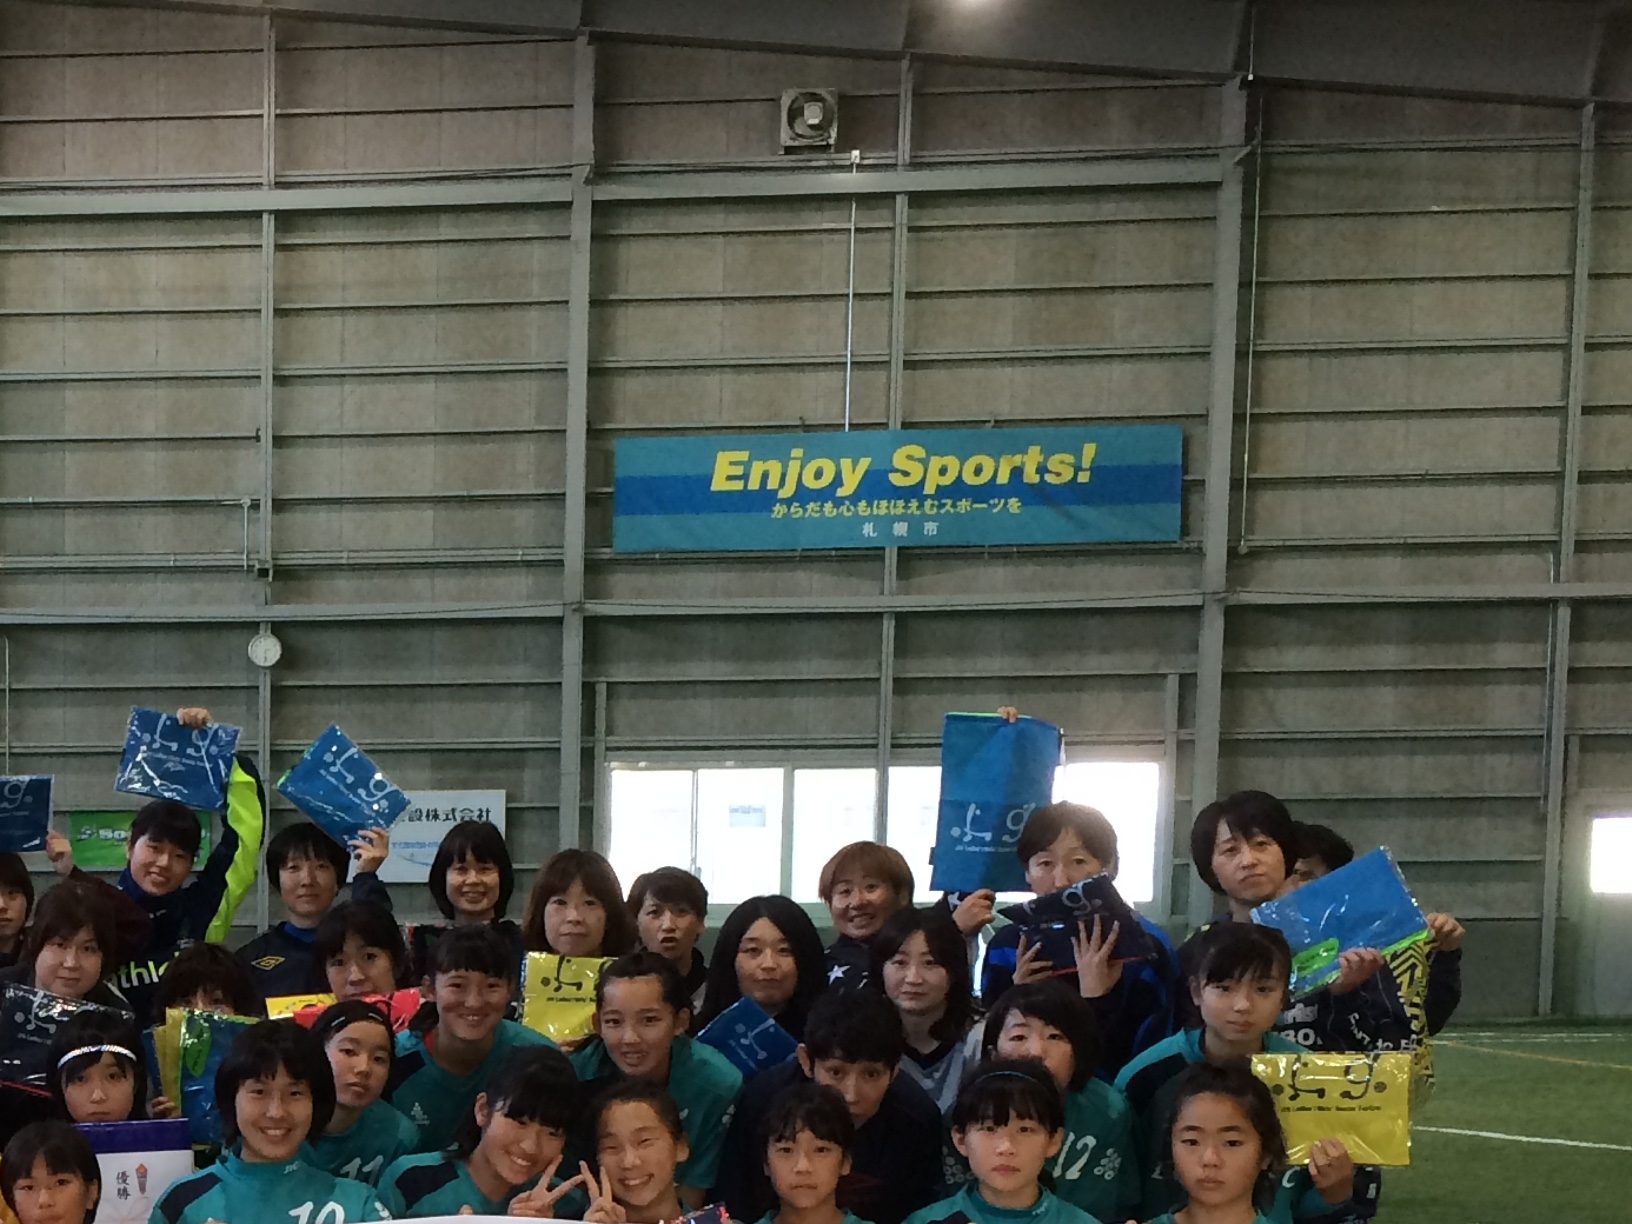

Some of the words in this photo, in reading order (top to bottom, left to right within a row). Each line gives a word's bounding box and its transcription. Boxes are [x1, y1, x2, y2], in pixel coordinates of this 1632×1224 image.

[710, 448, 872, 499] Enjoy
[888, 443, 1098, 496] Sports!
[771, 497, 1022, 519] からだも心もほほえむスポーツを
[400, 807, 492, 823] 設株式会社
[340, 1154, 384, 1187] 11
[1052, 1132, 1097, 1180] 12
[115, 1170, 132, 1200] 優勝
